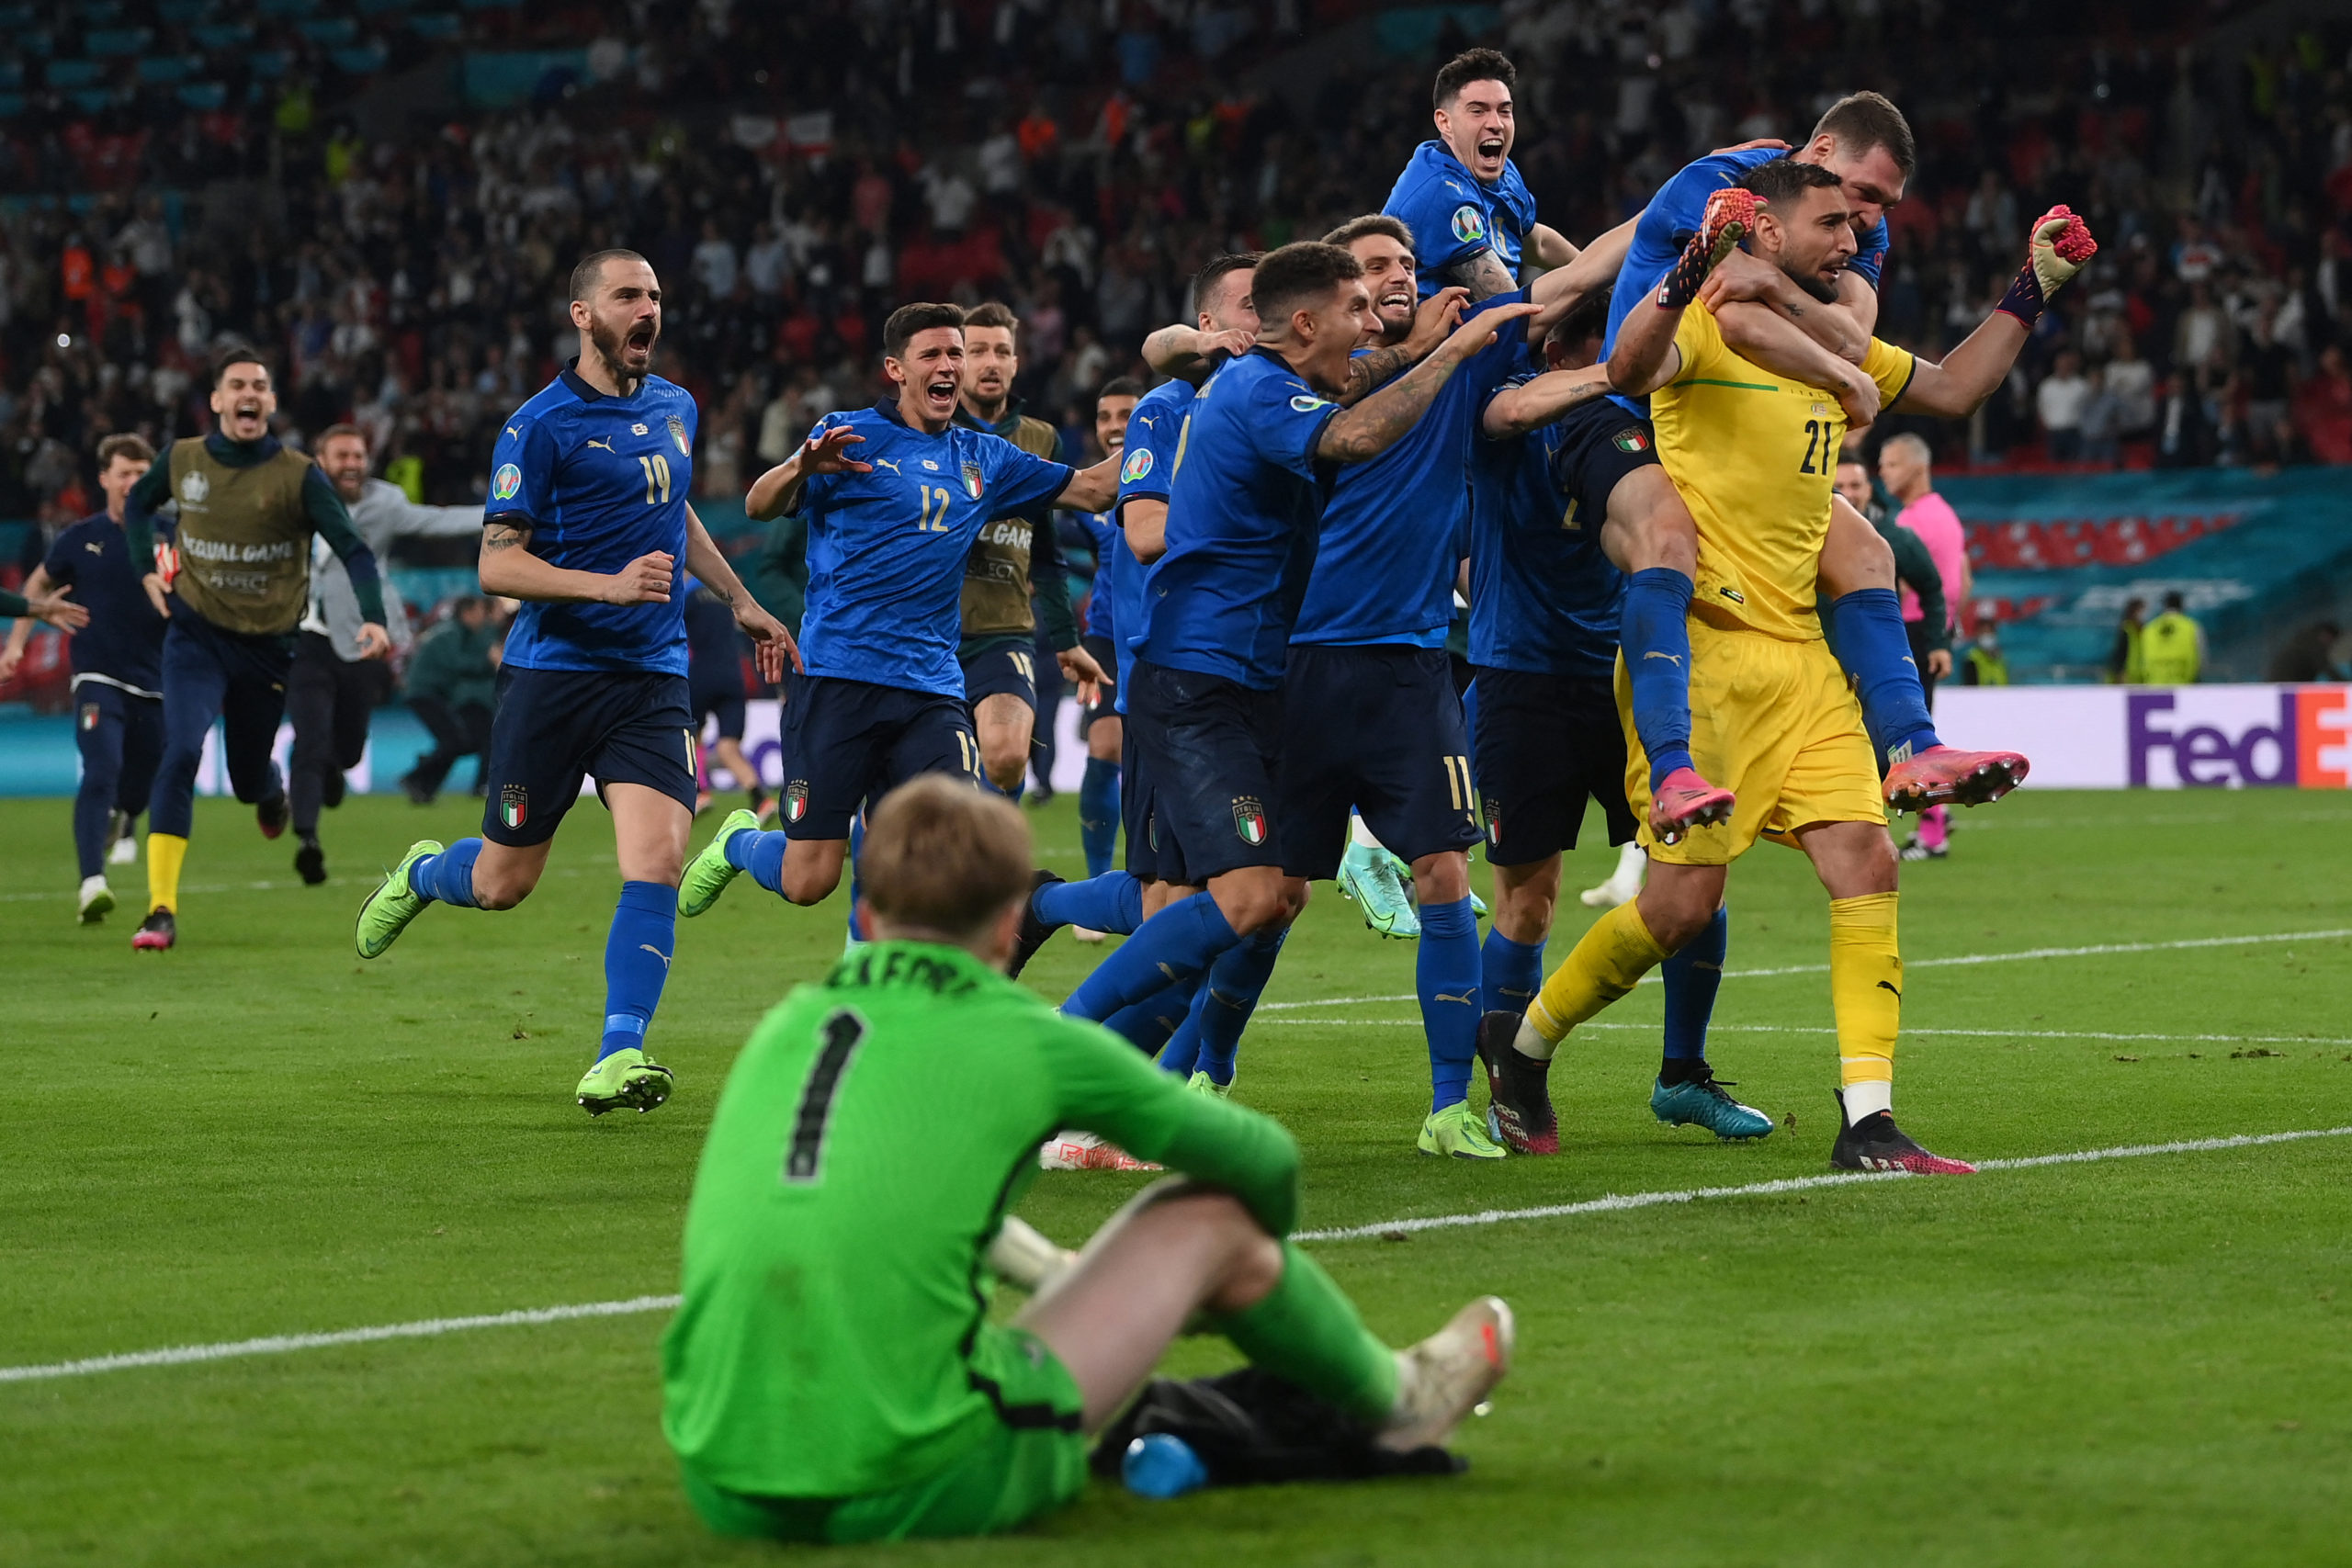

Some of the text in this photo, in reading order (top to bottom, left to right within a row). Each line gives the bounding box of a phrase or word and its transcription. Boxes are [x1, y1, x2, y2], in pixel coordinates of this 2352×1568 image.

[1800, 419, 1832, 476] 21
[639, 454, 671, 504] 19
[919, 485, 950, 532] 12
[2127, 689, 2352, 788] FedE
[1443, 756, 1475, 810] 11
[781, 1007, 868, 1185] 1
